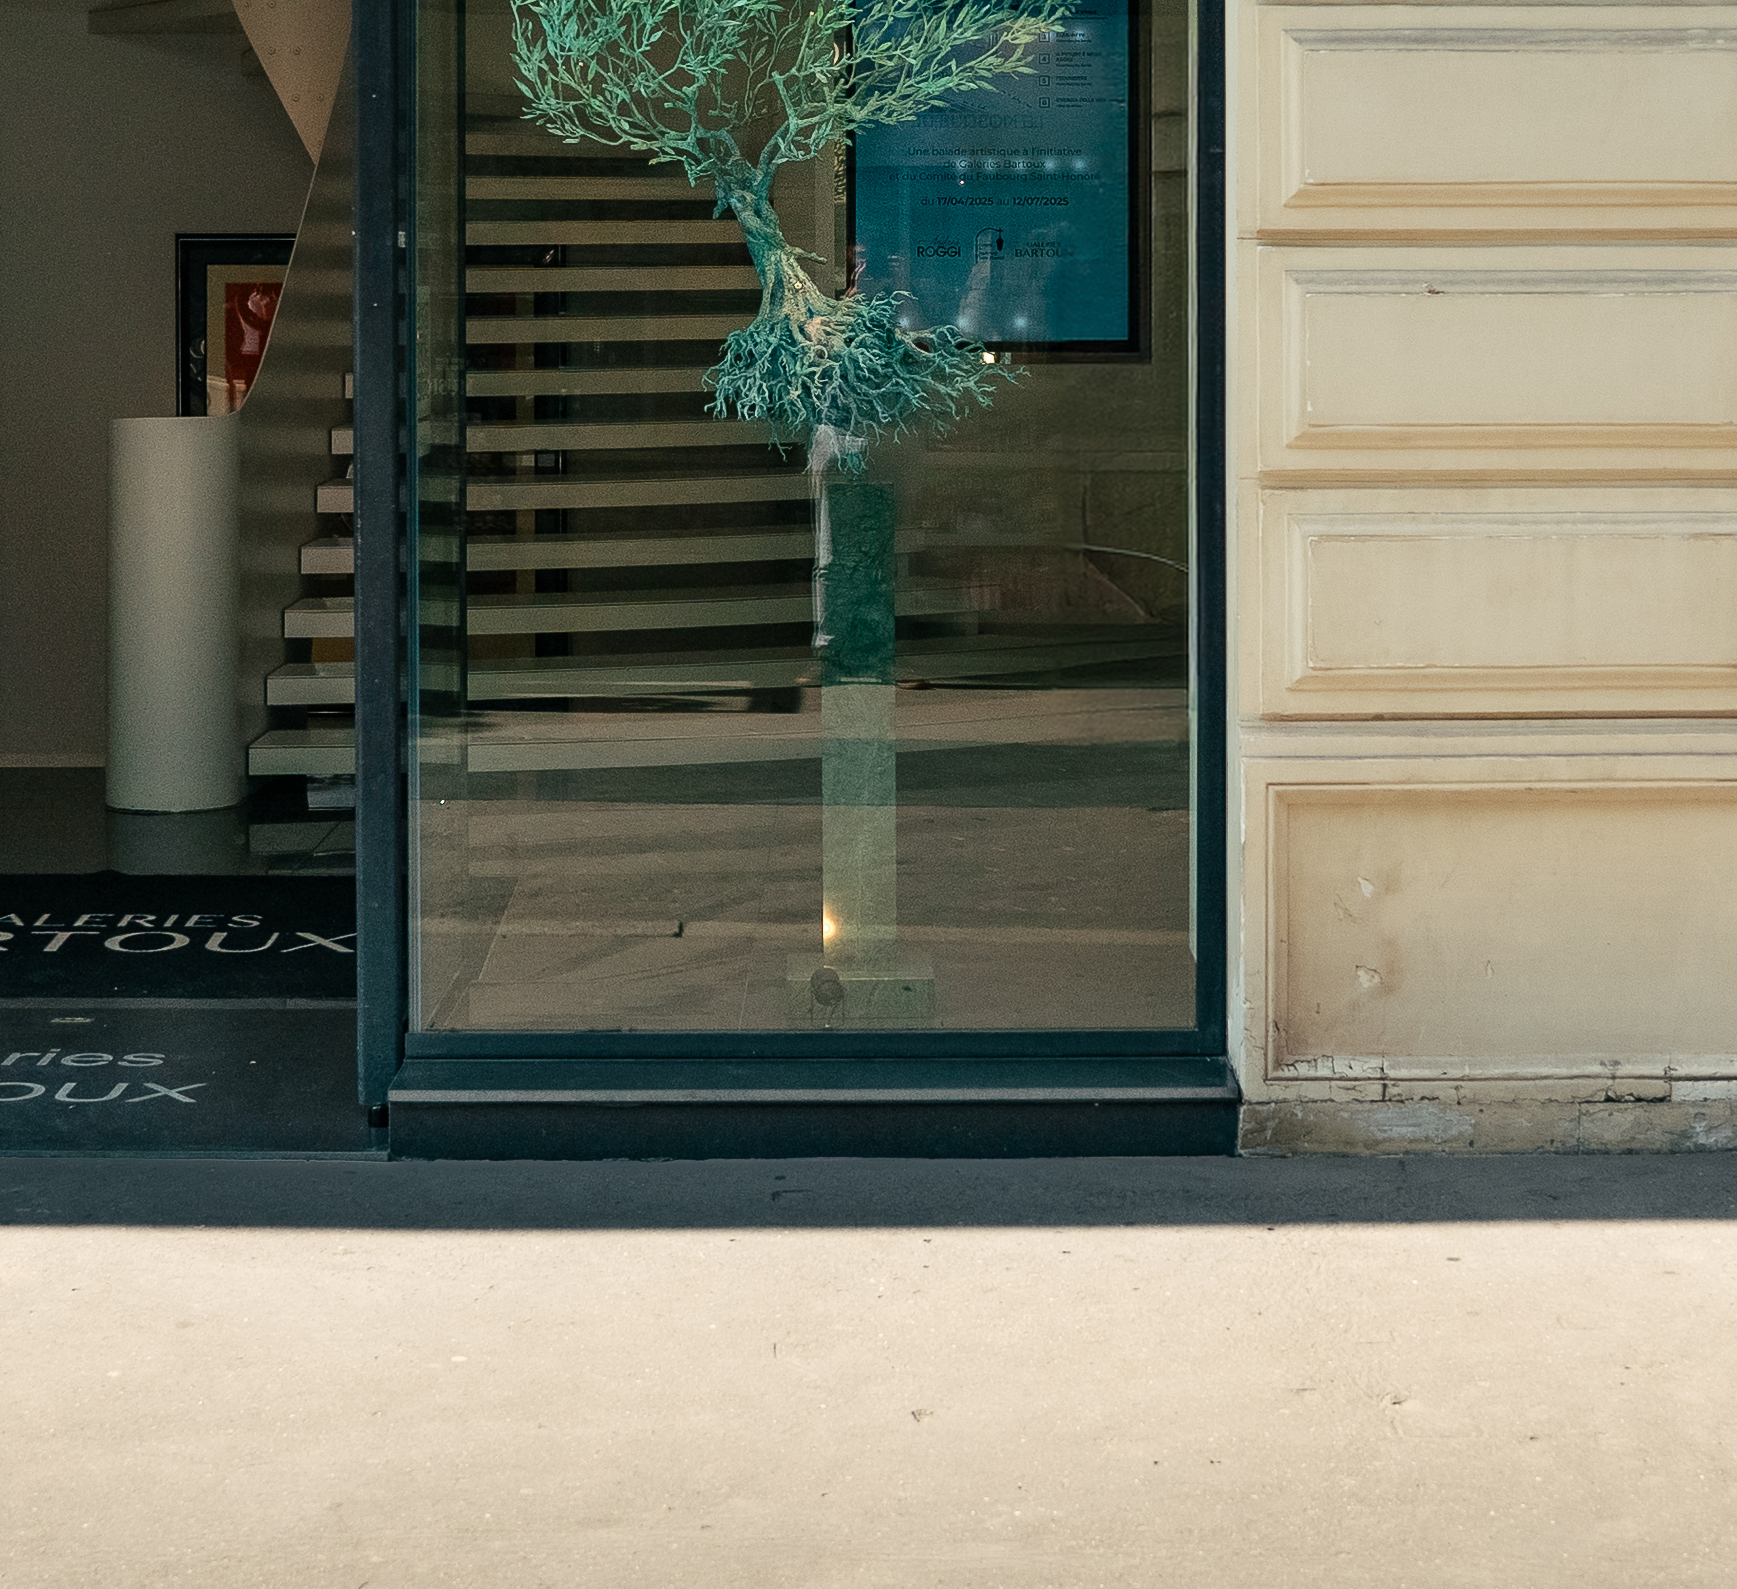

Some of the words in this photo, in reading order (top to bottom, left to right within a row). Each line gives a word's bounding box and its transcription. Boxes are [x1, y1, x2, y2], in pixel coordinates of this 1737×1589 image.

[908, 147, 929, 156] Une
[931, 147, 967, 156] balade
[969, 147, 1020, 159] artistique
[1022, 147, 1029, 156] à
[1031, 147, 1082, 156] l'initiative
[943, 160, 955, 169] de
[959, 160, 1000, 169] Galeries
[1003, 160, 1046, 169] Bartoux
[889, 172, 900, 181] et
[902, 172, 916, 181] du
[919, 172, 957, 181] Comité
[960, 172, 974, 181] du
[976, 172, 1028, 183] Faubourg
[920, 196, 934, 206] du
[937, 196, 994, 206] 17/04/2025
[997, 198, 1009, 206] au
[1012, 196, 1069, 206] 12/07/2025
[916, 246, 961, 258] ROGGI
